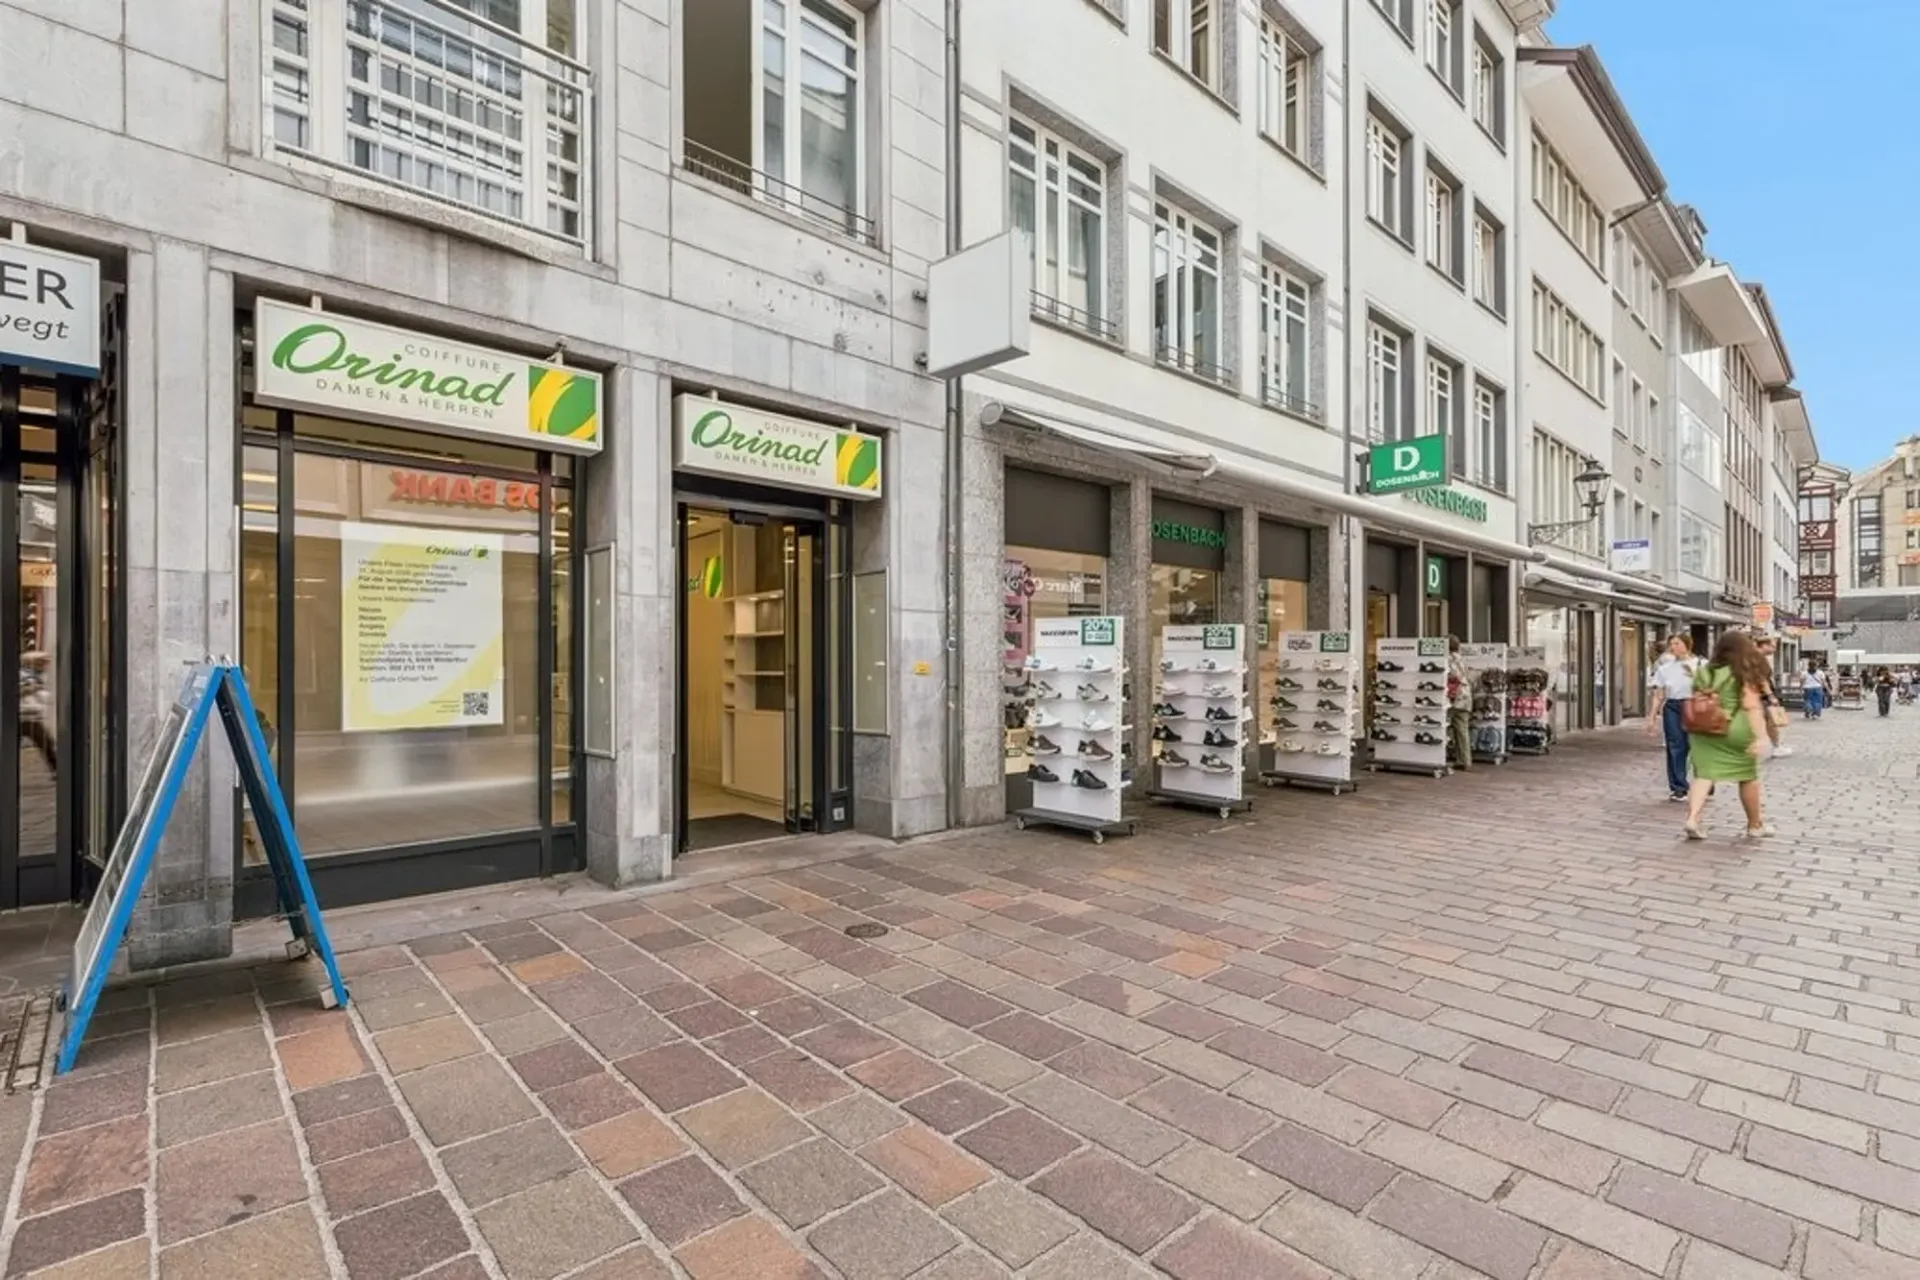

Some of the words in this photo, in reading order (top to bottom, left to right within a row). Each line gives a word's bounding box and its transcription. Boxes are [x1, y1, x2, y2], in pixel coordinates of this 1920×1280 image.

[272, 323, 517, 408] Orinad
[404, 343, 503, 373] COIFFURE
[315, 377, 391, 402] DAMEN
[398, 393, 410, 405] &
[417, 397, 495, 419] HERREN
[691, 410, 829, 467] Orinad
[764, 421, 822, 440] COIFFURE
[714, 450, 756, 466] DAMEN
[772, 461, 817, 477] HERREN
[1393, 445, 1421, 472] D
[1376, 470, 1440, 488] DOSENBACH
[1428, 563, 1440, 588] D
